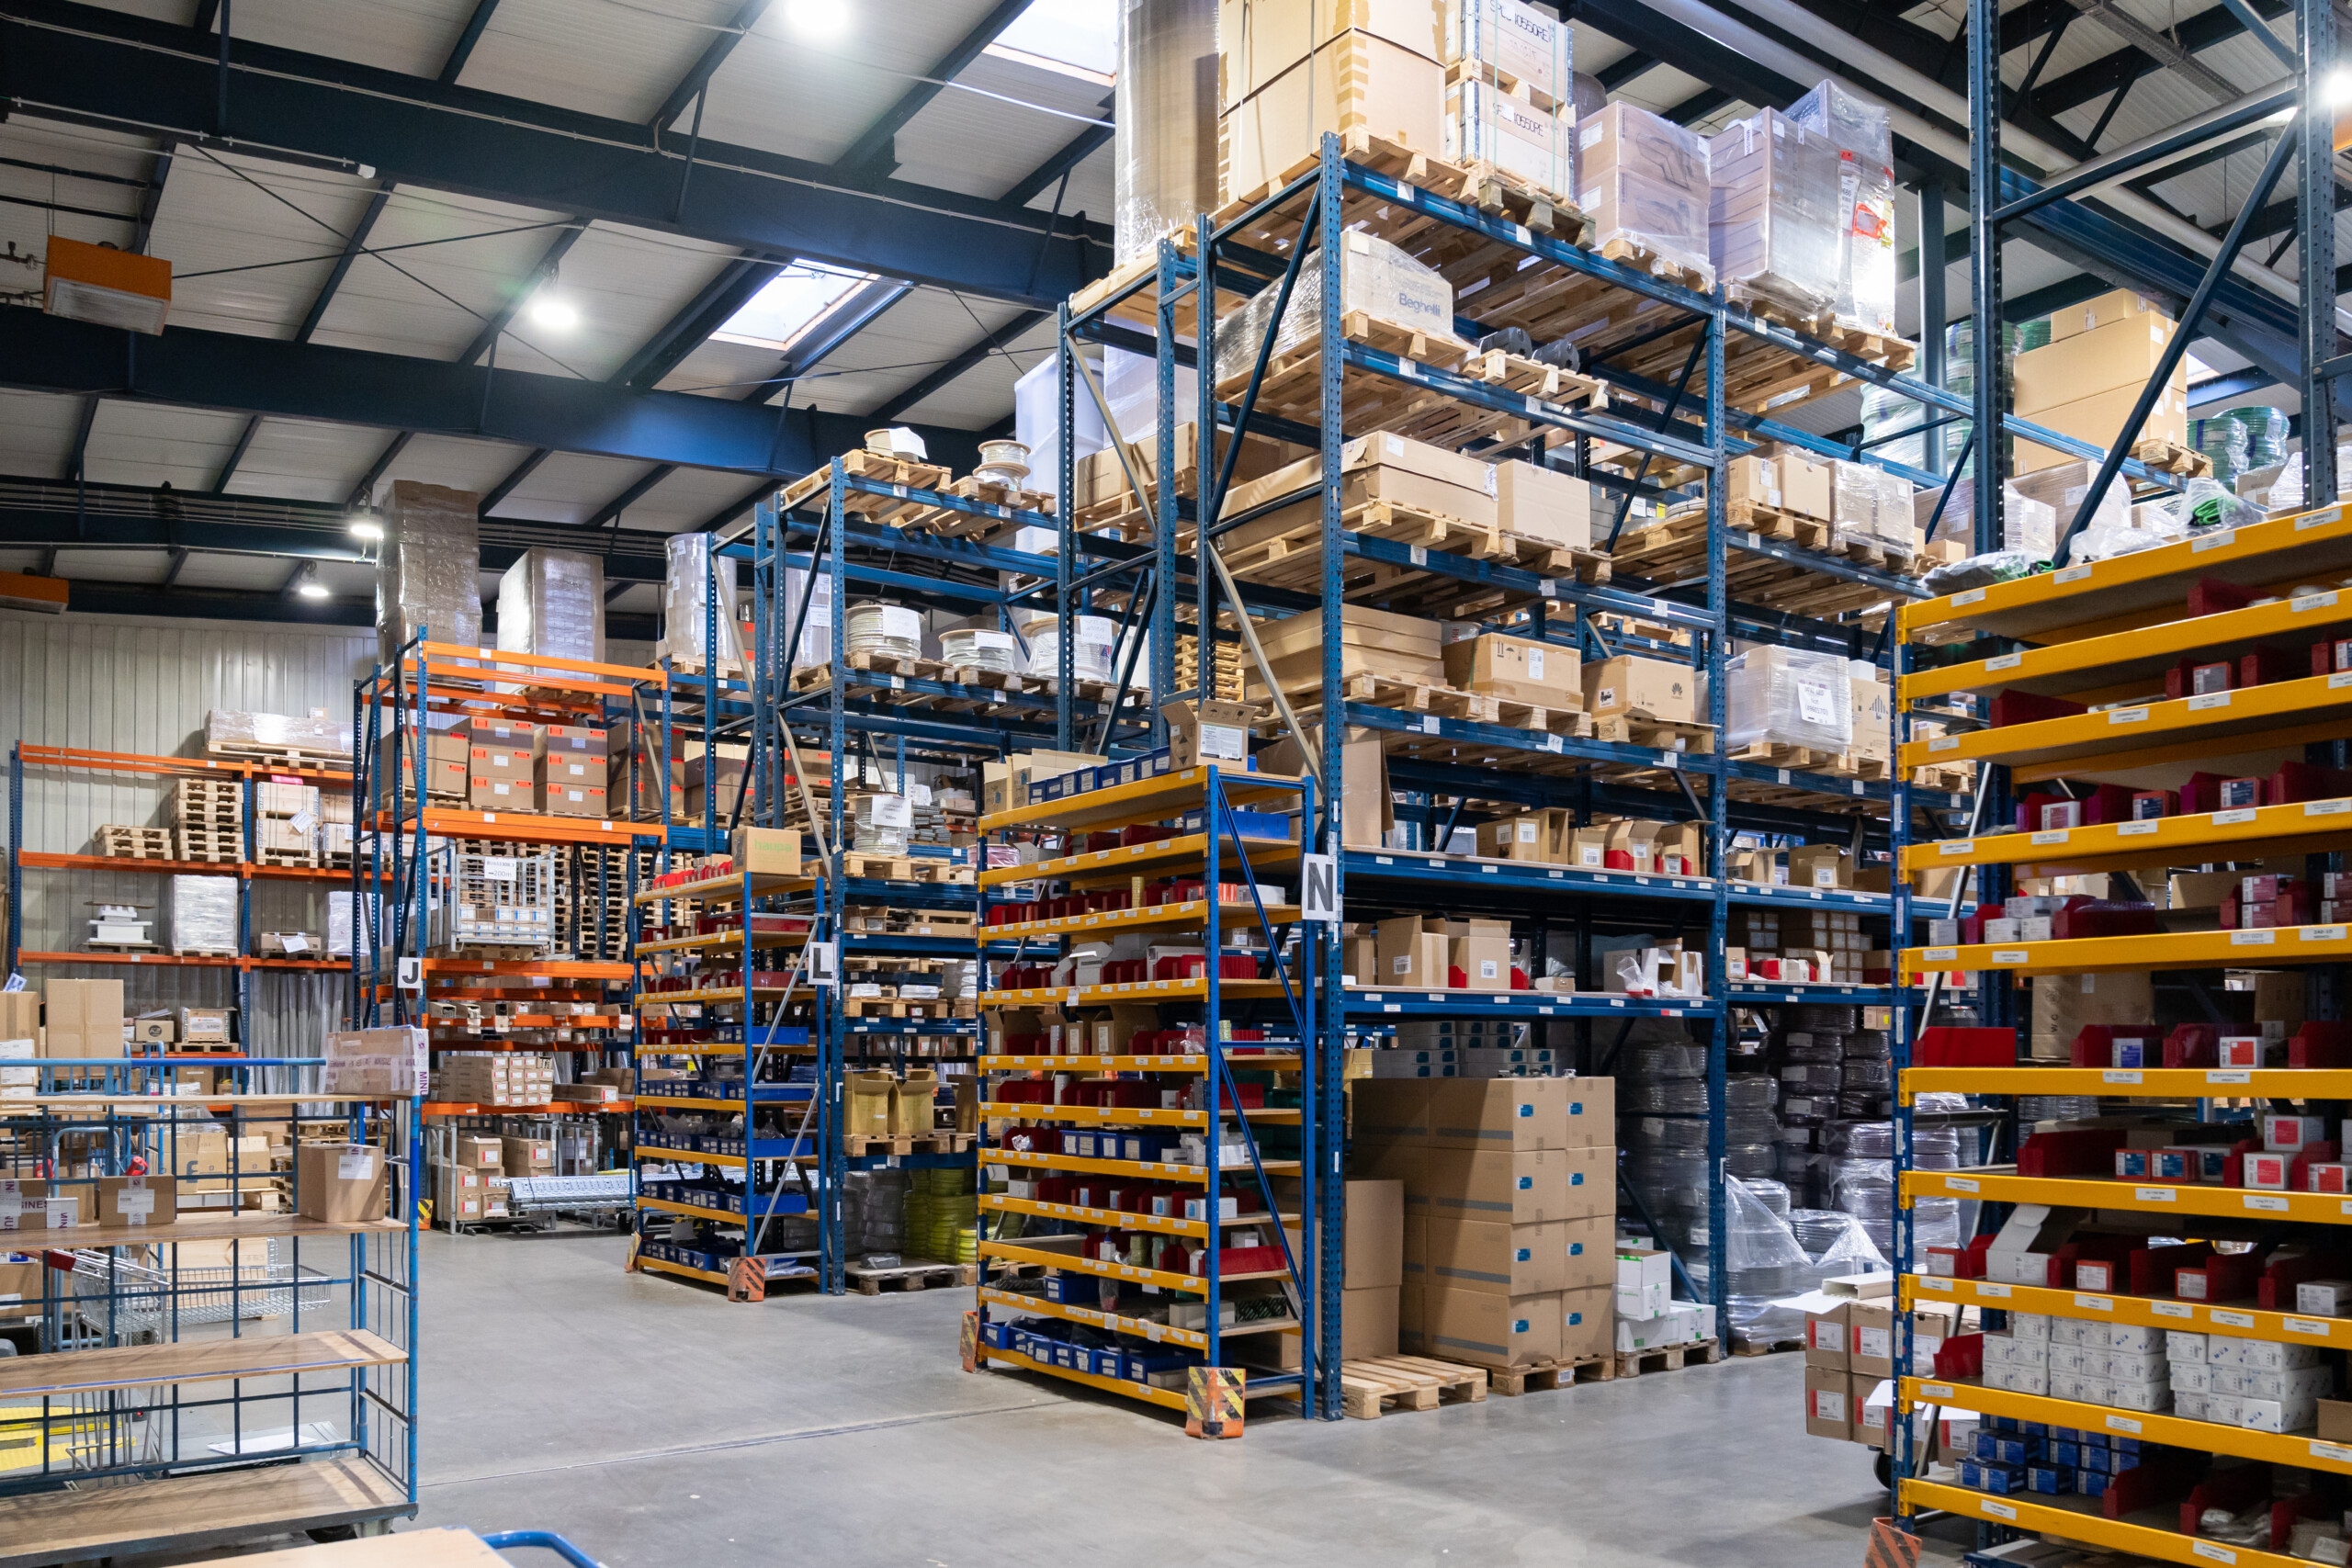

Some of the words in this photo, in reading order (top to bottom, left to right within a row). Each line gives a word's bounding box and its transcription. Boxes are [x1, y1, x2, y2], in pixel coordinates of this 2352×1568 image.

[1398, 292, 1441, 318] Beghelli
[1426, 719, 1437, 732] 10
[754, 840, 792, 853] haupa
[1307, 863, 1333, 912] N
[402, 962, 418, 984] J
[813, 948, 832, 979] L
